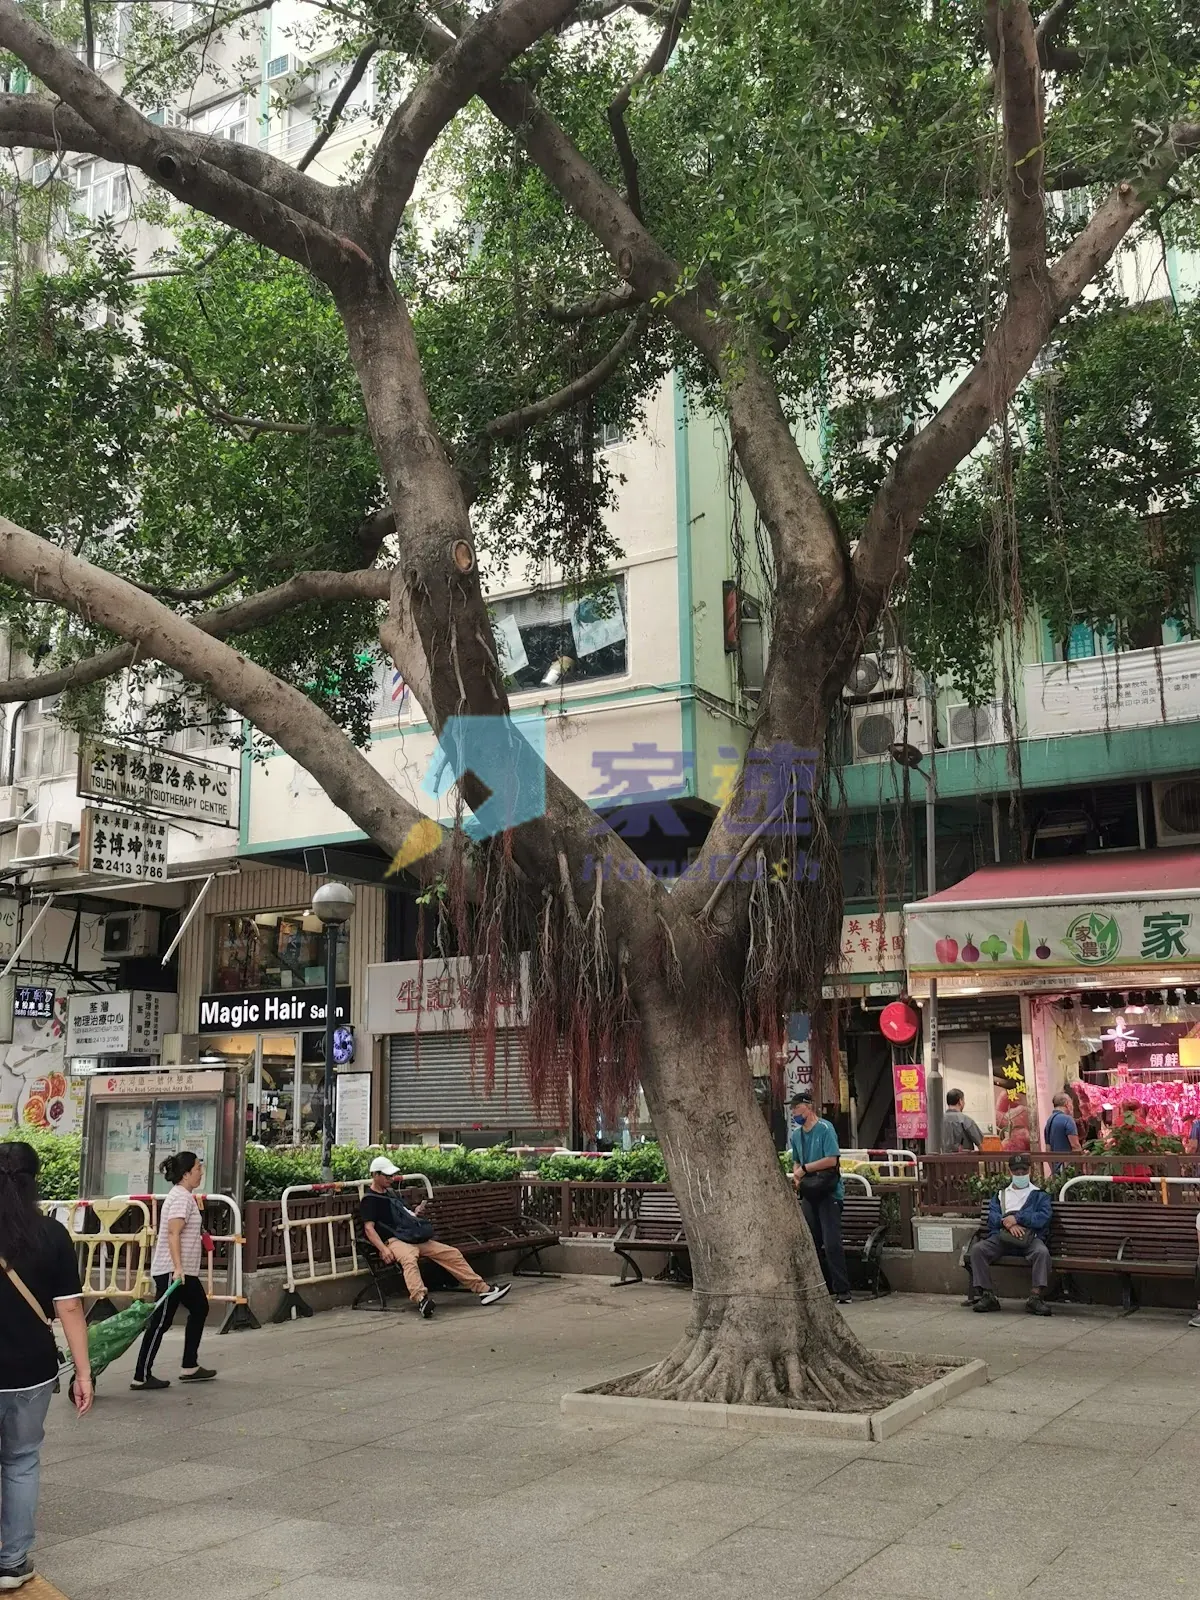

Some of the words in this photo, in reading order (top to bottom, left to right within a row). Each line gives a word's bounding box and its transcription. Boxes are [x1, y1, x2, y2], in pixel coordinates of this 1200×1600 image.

[90, 774, 117, 791] TSUEN
[120, 780, 137, 795] WAN
[139, 785, 197, 809] PHYSIOTHERAPY
[199, 799, 228, 816] CENTRE
[93, 828, 143, 861] 李博坤
[106, 859, 132, 874] 2413
[135, 864, 163, 879] 3786
[1074, 925, 1100, 958] 家農
[1139, 911, 1192, 961] 家
[73, 1013, 124, 1028] 物理治療中心
[89, 1001, 110, 1014] 荃灣
[200, 999, 260, 1029] Magic
[264, 995, 306, 1021] Hair
[310, 1003, 344, 1020] Saln
